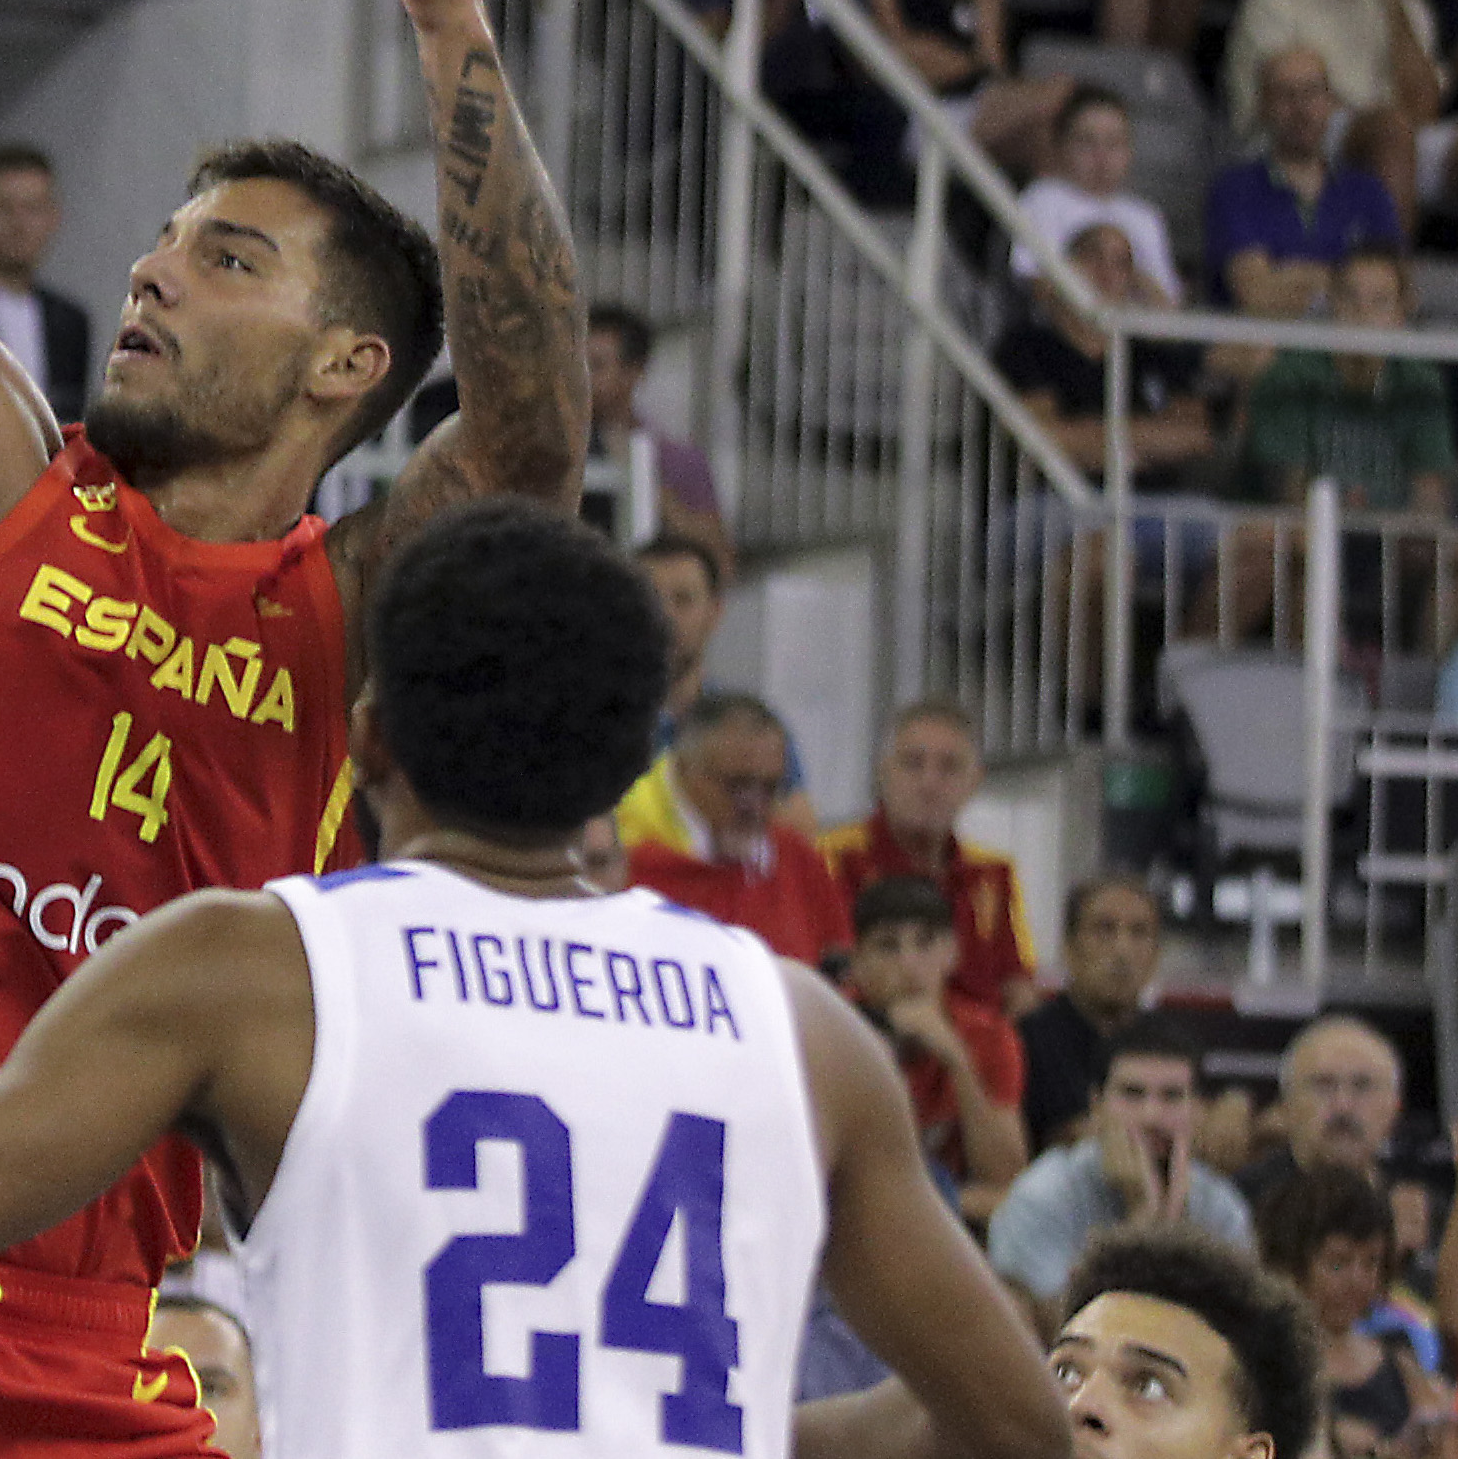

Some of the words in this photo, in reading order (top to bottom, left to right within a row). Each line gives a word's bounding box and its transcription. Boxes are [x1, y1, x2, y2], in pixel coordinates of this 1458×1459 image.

[19, 562, 295, 733] ESPAÑA
[89, 710, 173, 843] 14
[402, 926, 742, 1043] FIGUEROA
[423, 1088, 744, 1456] 24
